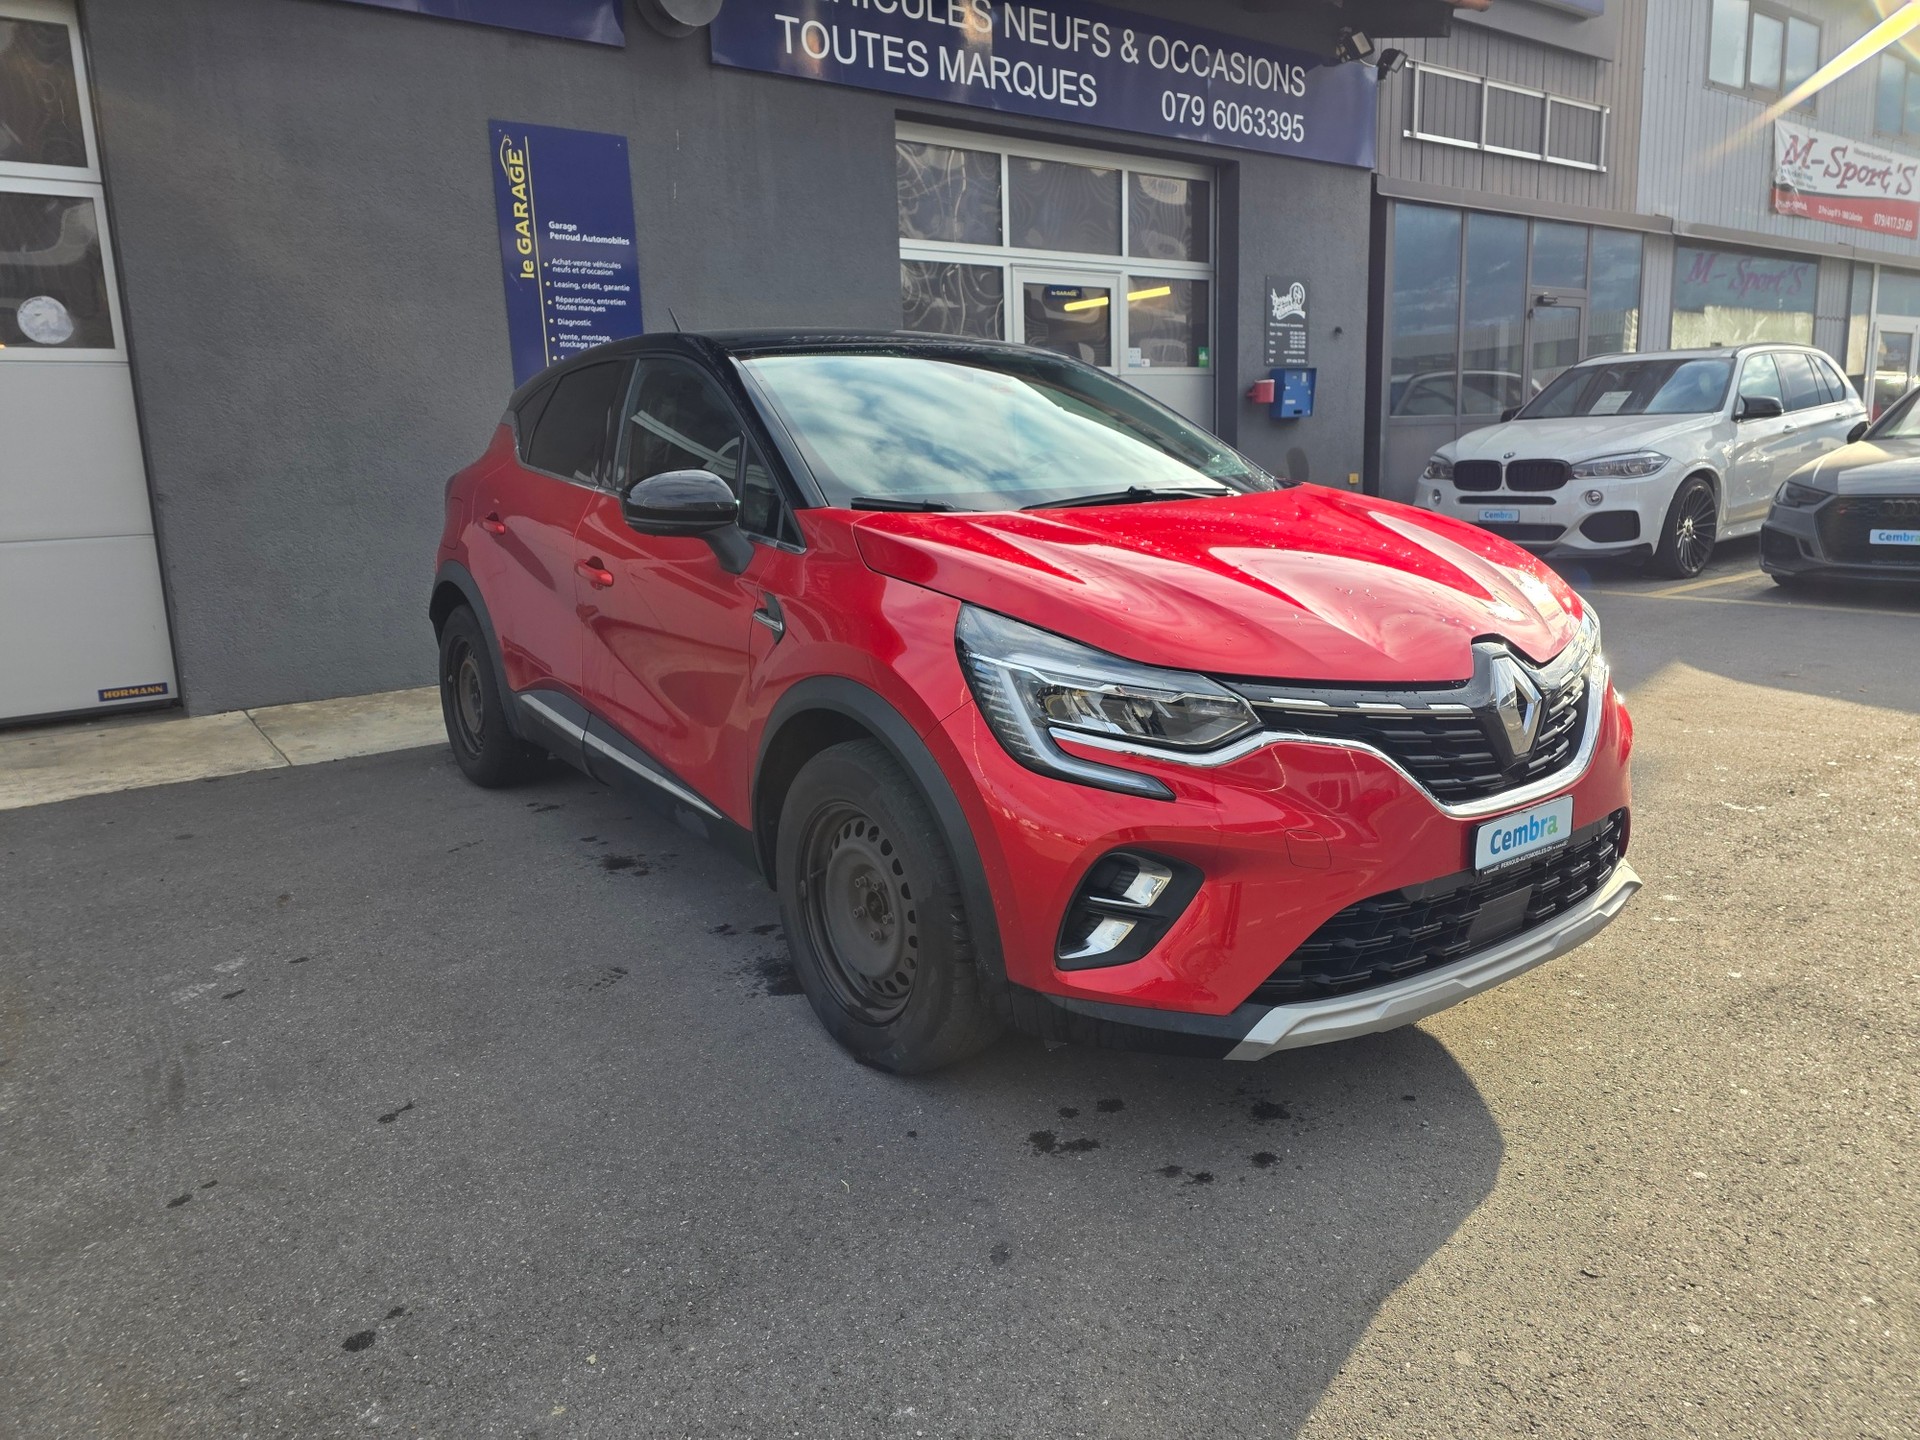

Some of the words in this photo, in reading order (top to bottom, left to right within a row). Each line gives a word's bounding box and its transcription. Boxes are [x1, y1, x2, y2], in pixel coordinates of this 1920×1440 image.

[1004, 3, 1111, 58] NEUFS
[1120, 29, 1140, 64] &
[1148, 35, 1306, 97] OCCASIONS
[775, 14, 929, 77] TOUTES
[939, 46, 1097, 107] MARQUES
[1161, 90, 1205, 126] 079
[1212, 100, 1305, 143] 6063395
[507, 148, 533, 255] GARAGE
[548, 221, 577, 232] Garage
[549, 231, 580, 242] Perroud
[582, 234, 630, 246] Automobiles
[519, 260, 535, 278] le
[551, 258, 591, 268] Achat-vente
[592, 261, 622, 270] véhicules
[552, 266, 571, 274] neufs
[572, 267, 580, 275] et
[580, 267, 614, 276] d'occasion
[553, 281, 580, 290] Leasing,
[581, 282, 602, 291] crédit,
[603, 284, 631, 292] garantie
[555, 295, 596, 305] Réparations,
[597, 298, 626, 306] entretien
[556, 303, 577, 311] toutes
[578, 305, 606, 313] marques
[557, 318, 592, 327] Diagnostic
[558, 333, 580, 341] Vente,
[581, 335, 612, 343] montage,
[559, 340, 588, 350] stockage
[1484, 511, 1513, 519] Cembra
[1490, 814, 1558, 855] Cembra
